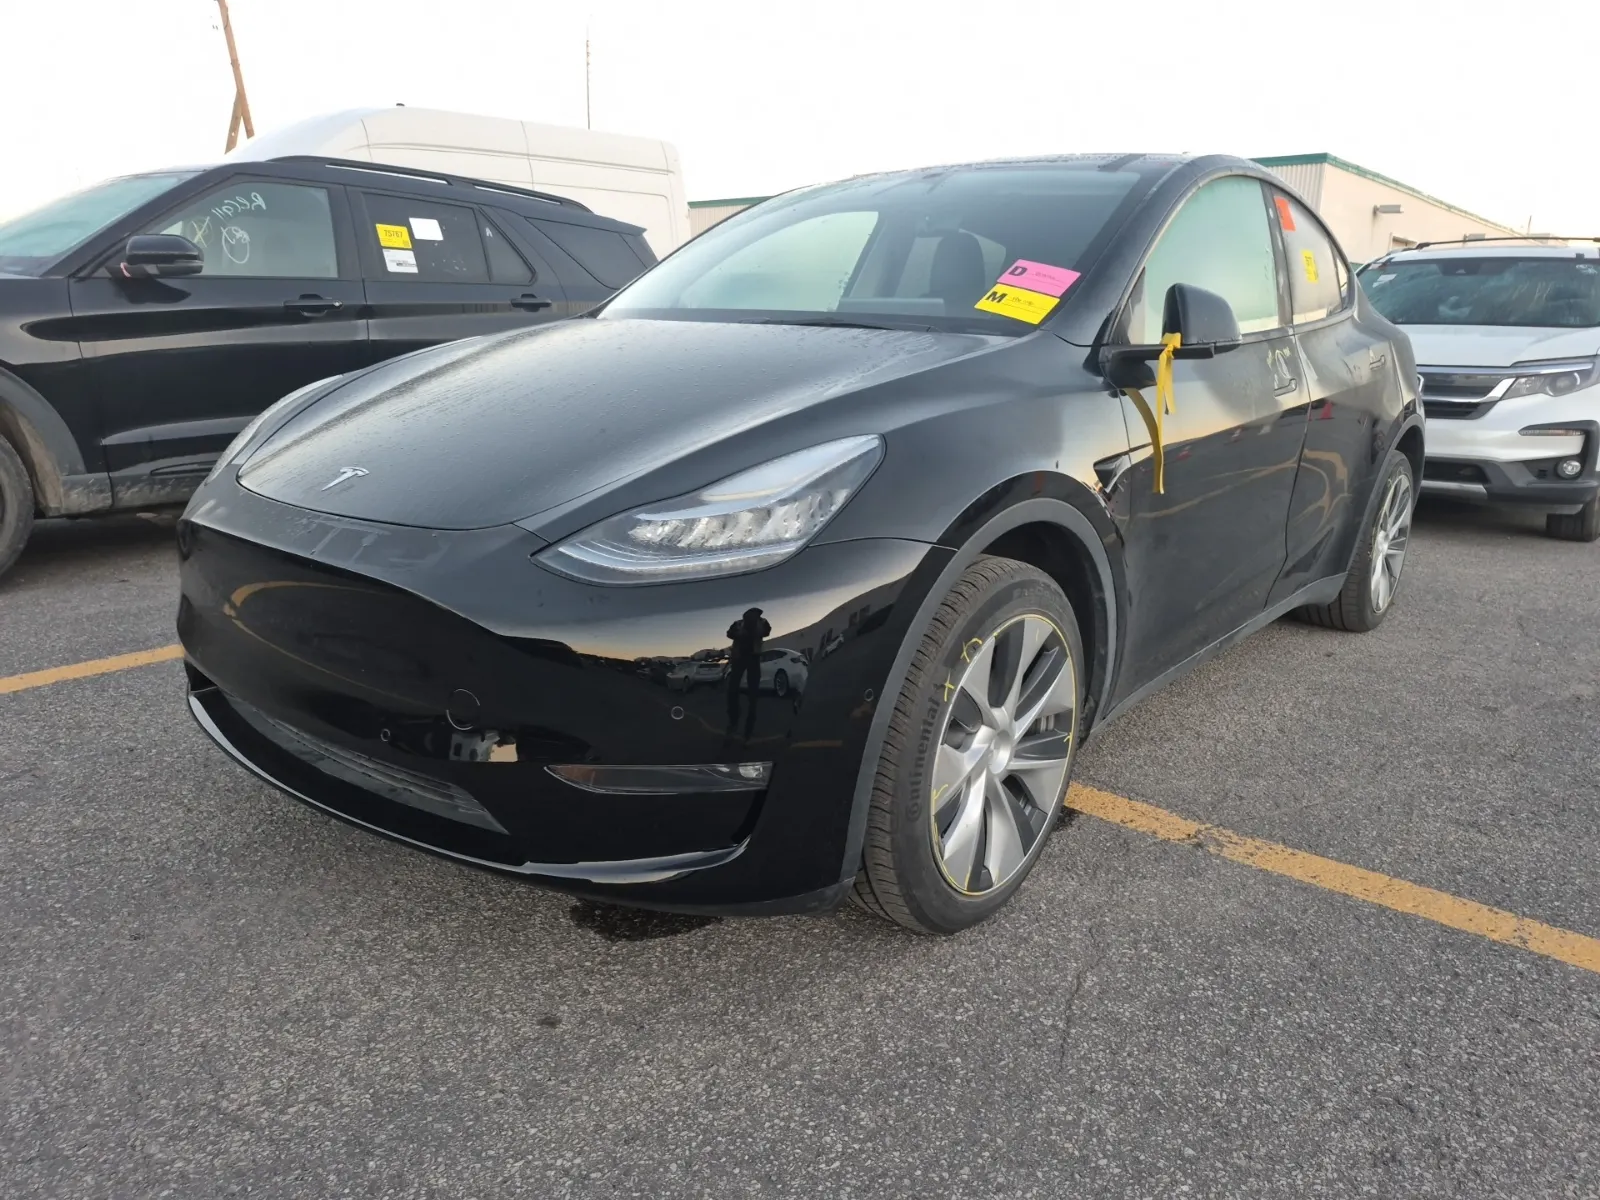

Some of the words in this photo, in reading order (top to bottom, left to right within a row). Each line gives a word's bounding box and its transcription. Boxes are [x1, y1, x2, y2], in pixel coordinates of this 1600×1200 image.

[1008, 266, 1028, 276] D
[985, 291, 1008, 304] M
[905, 696, 941, 823] Continental
